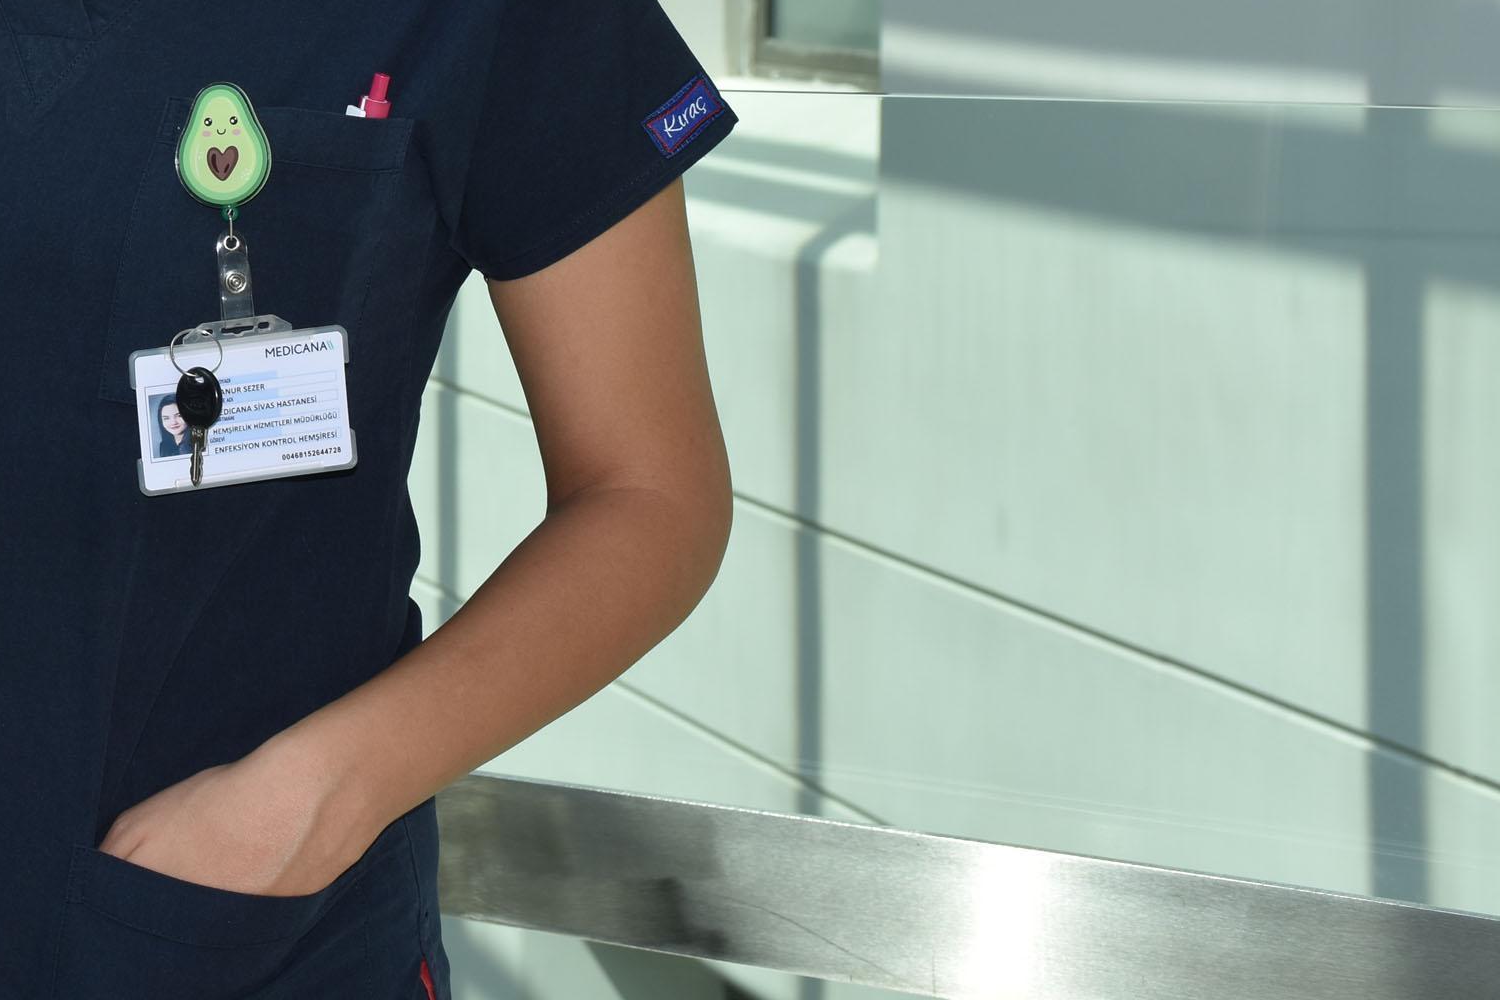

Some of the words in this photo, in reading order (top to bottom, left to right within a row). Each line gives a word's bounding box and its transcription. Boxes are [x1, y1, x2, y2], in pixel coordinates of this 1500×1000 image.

[265, 341, 328, 358] MEDICANA
[221, 386, 242, 395] ANUR
[243, 383, 265, 393] SEZER
[220, 406, 252, 416] EDICANA
[253, 402, 275, 411] SİVAS
[276, 396, 317, 408] HASTANESİ
[213, 424, 252, 435] HEMŞİRELİK
[253, 418, 293, 430] HİZMETLERİ
[293, 411, 338, 424] MÜDÜRLÜĞÜ
[214, 441, 260, 454] ENFEKSİYON
[261, 436, 297, 448] KONTROL
[298, 430, 338, 443] HEMŞİRESİ
